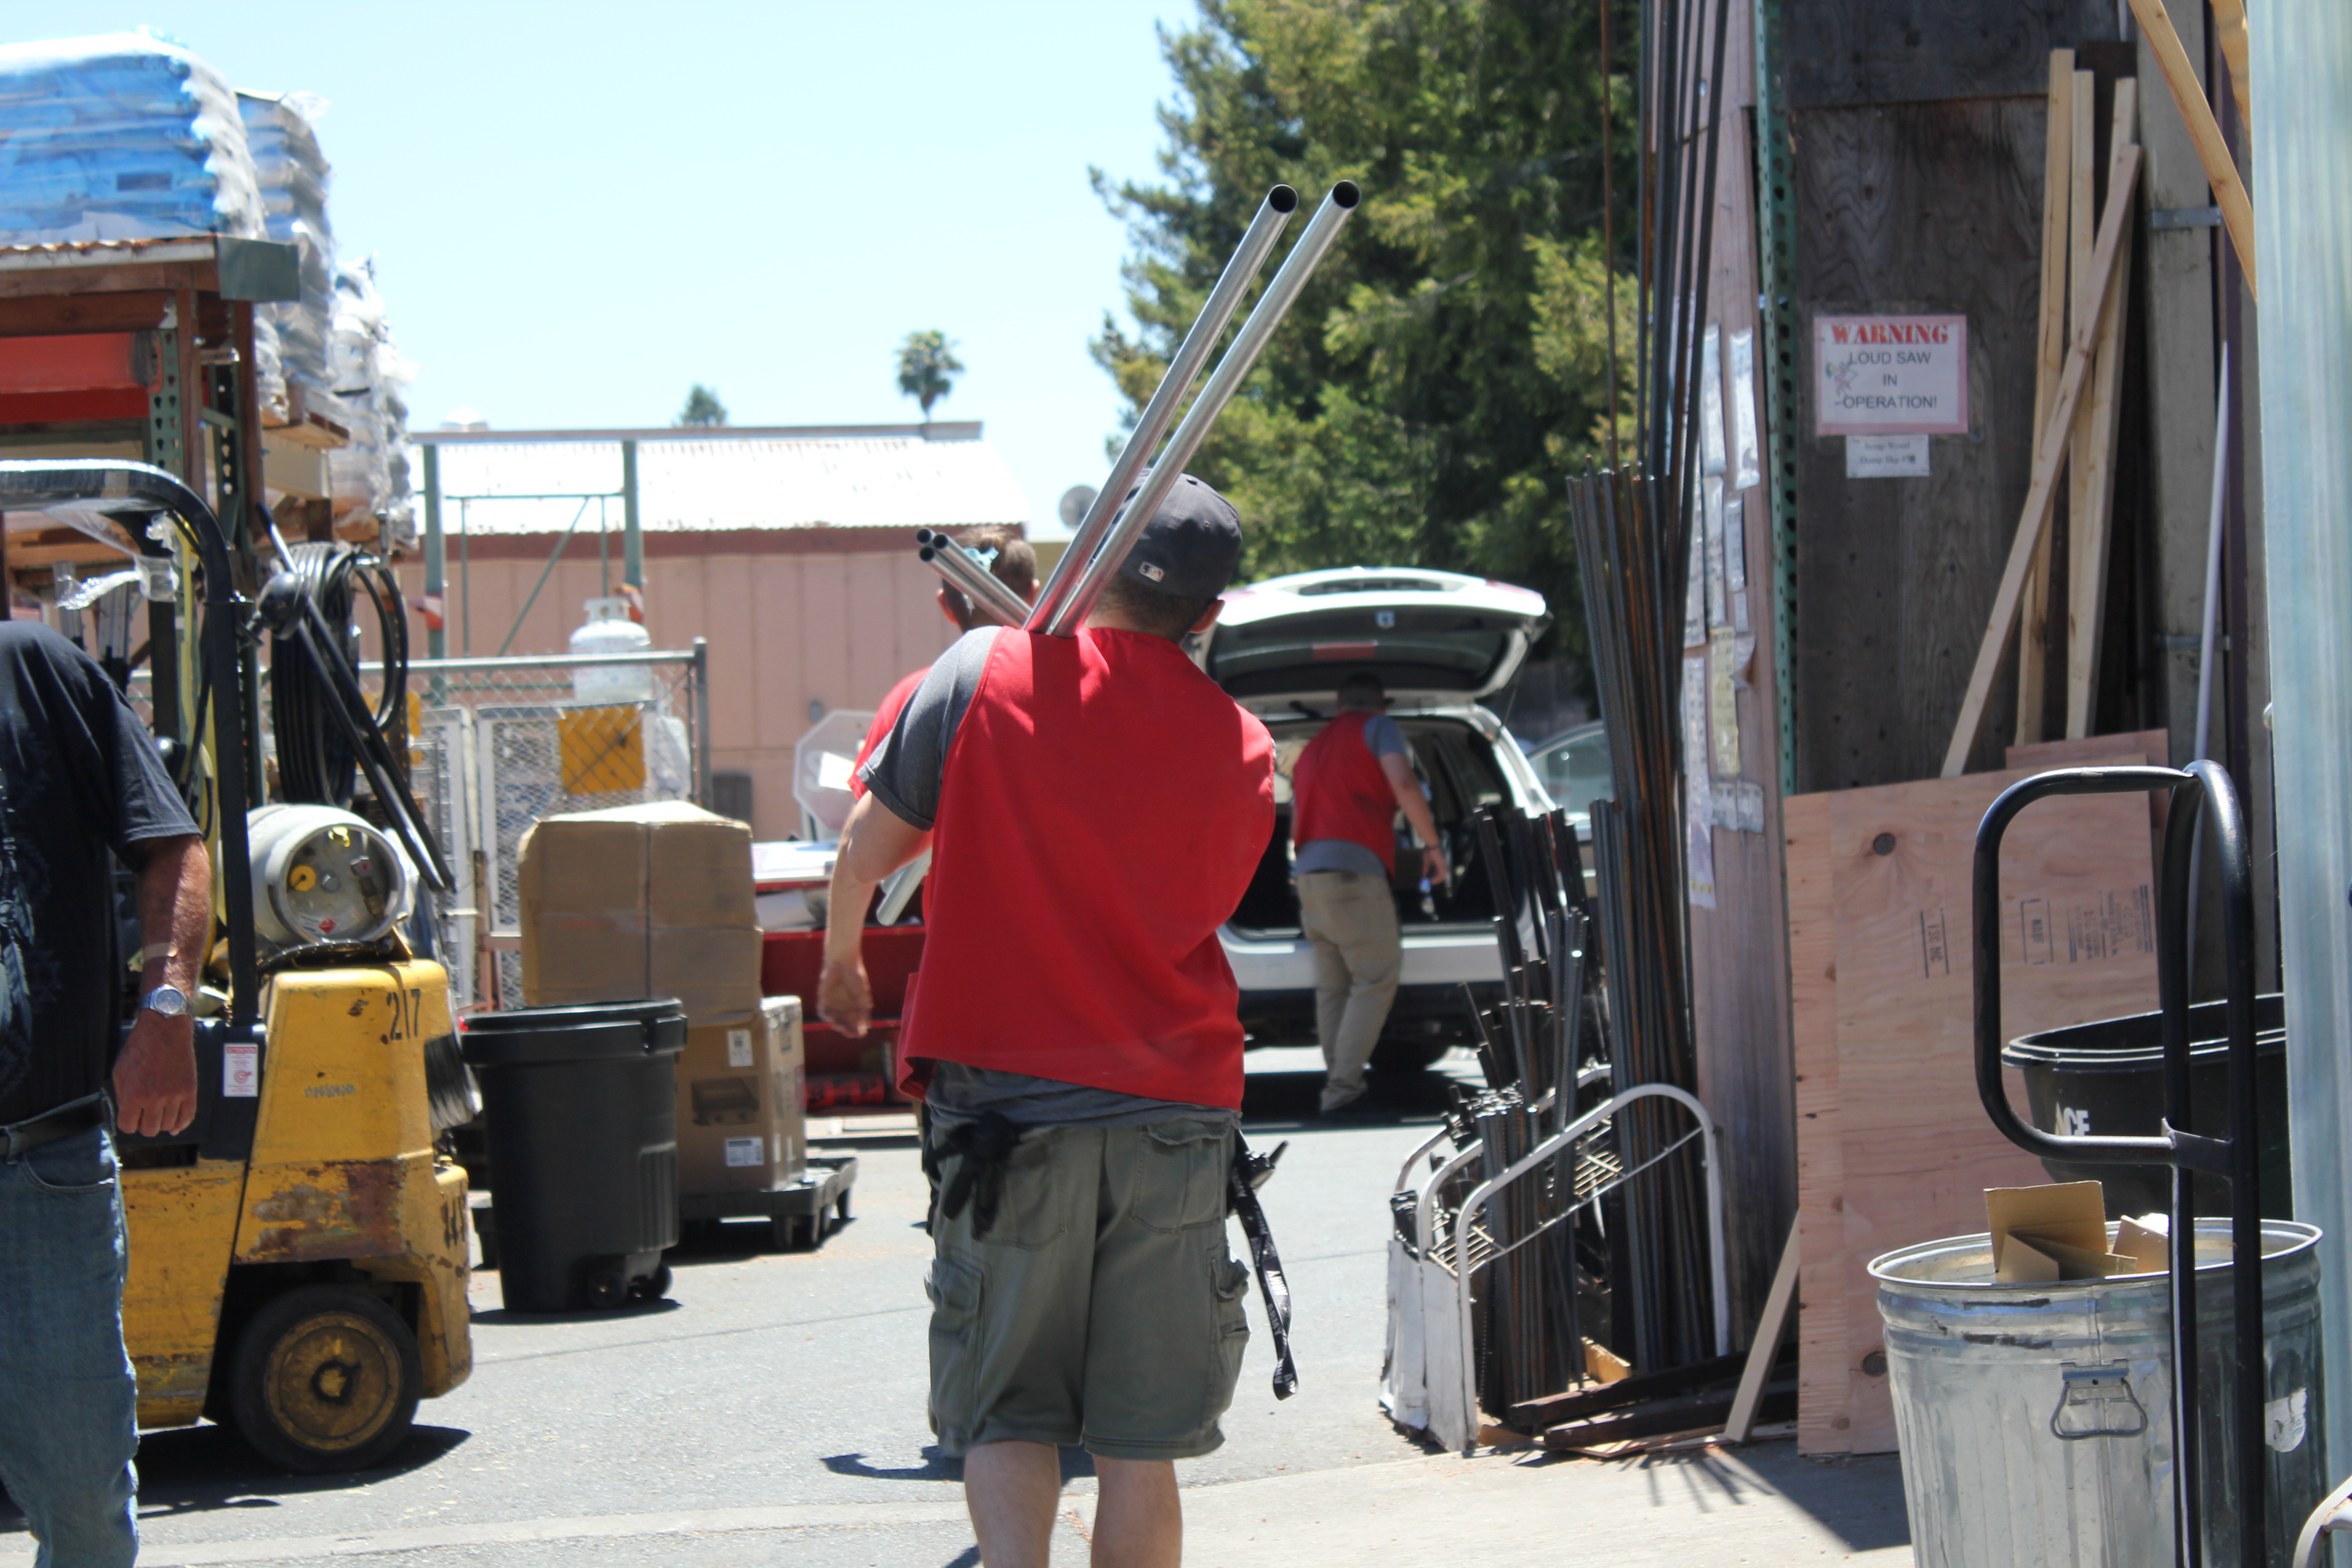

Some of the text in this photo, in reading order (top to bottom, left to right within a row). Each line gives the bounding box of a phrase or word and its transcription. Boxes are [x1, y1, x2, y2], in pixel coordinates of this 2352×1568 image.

[1832, 324, 1949, 344] WARNING
[1849, 352, 1932, 364] LOUD SAW
[1882, 374, 1898, 387] IN
[1844, 396, 1938, 409] OPERATION!
[2055, 1100, 2091, 1136] ACE
[1266, 1270, 1289, 1296] ARMY
[1267, 1303, 1283, 1336] ARMY
